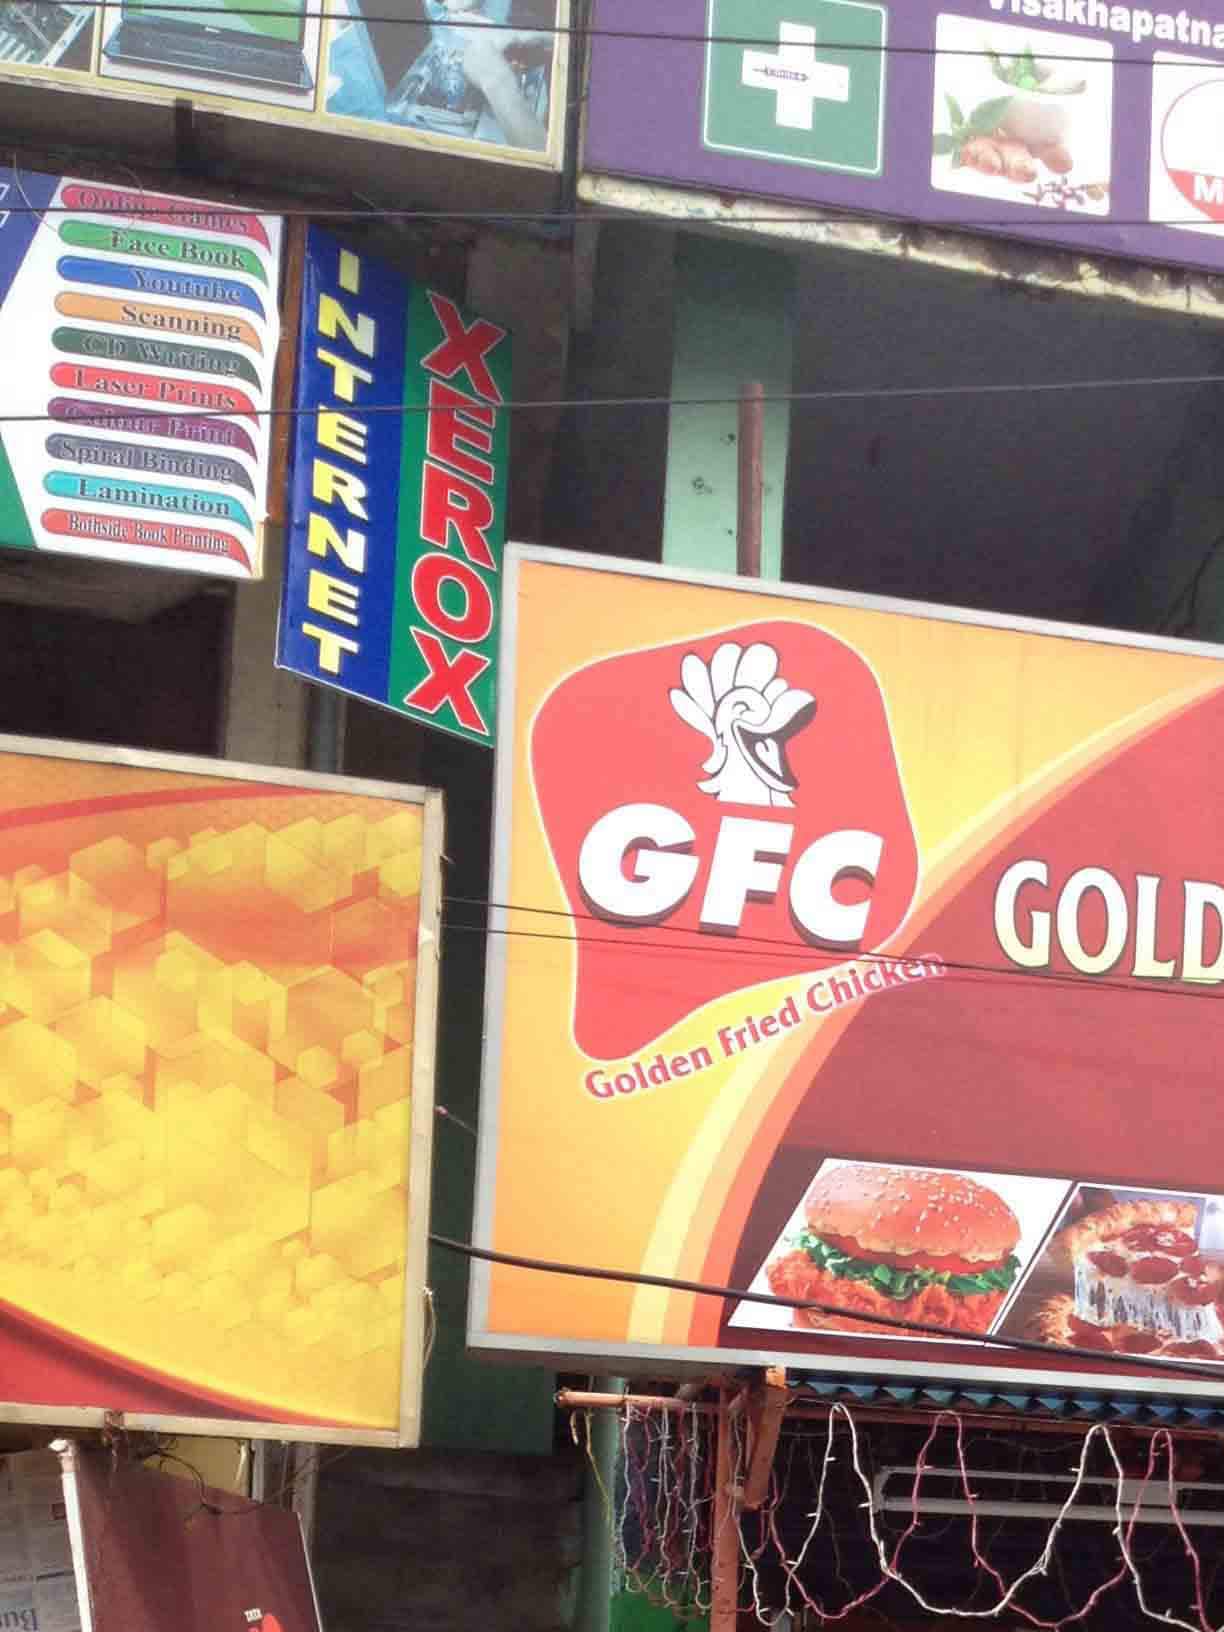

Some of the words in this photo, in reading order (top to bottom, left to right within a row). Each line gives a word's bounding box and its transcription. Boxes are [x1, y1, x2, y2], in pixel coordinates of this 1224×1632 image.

[111, 230, 170, 254] Face
[180, 240, 247, 269] Book
[129, 268, 241, 301] Youtube
[120, 304, 242, 341] Scanning
[73, 368, 148, 393] Laser
[159, 382, 236, 410] Prints
[60, 440, 135, 466] Spiral
[143, 450, 235, 484] Binding
[300, 249, 377, 676] INTERNET
[78, 478, 230, 516] Lamination
[404, 290, 509, 736] XEROX
[134, 521, 168, 545] Book
[174, 526, 231, 554] Printing
[577, 800, 886, 950] GFC
[583, 1044, 713, 1101] Golden
[717, 997, 802, 1058] Fried
[806, 953, 948, 1015] Chicken
